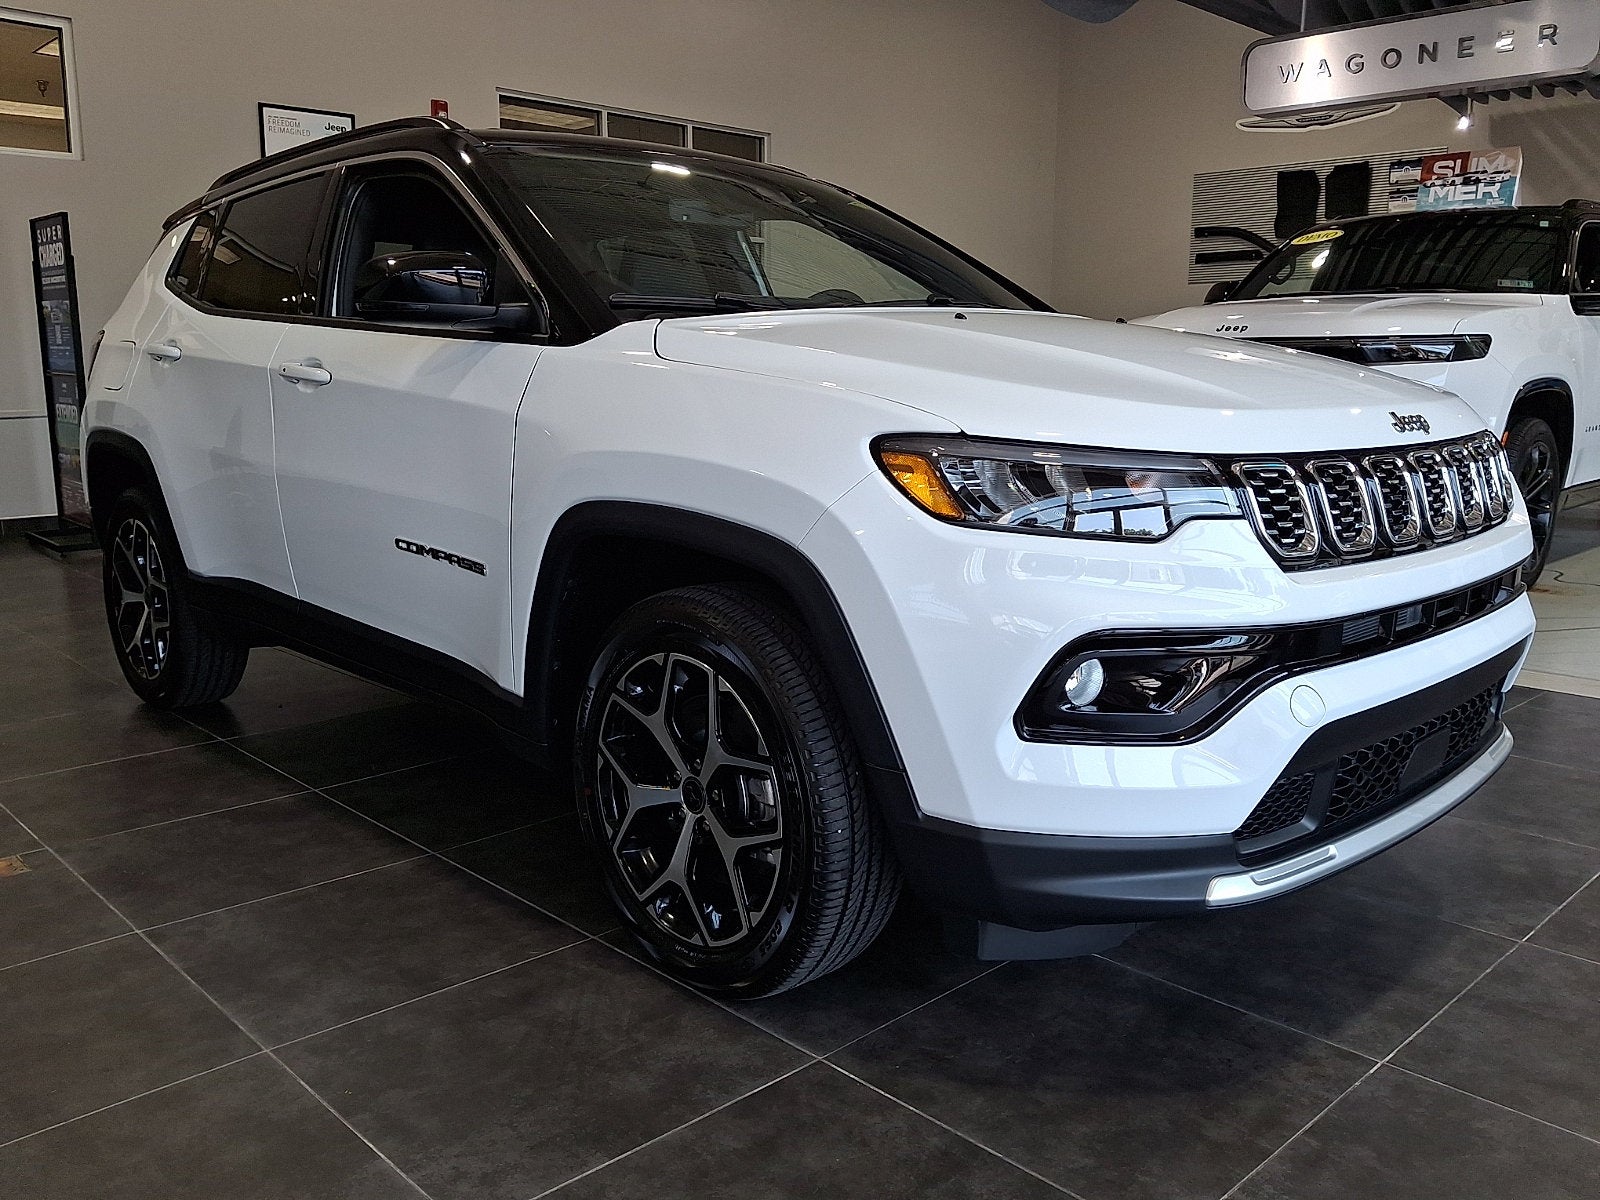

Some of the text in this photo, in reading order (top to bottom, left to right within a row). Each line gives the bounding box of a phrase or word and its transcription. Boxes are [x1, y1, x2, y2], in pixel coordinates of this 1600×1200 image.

[1279, 24, 1559, 84] WAGONEER
[267, 118, 301, 128] FREEDOM
[268, 126, 311, 137] REIMAGINED
[324, 122, 347, 133] Jeep
[1428, 181, 1502, 203] MER
[37, 225, 62, 243] SUPER
[1215, 324, 1249, 334] Jeep
[1389, 411, 1430, 435] Jeep
[394, 537, 487, 577] COMPASS
